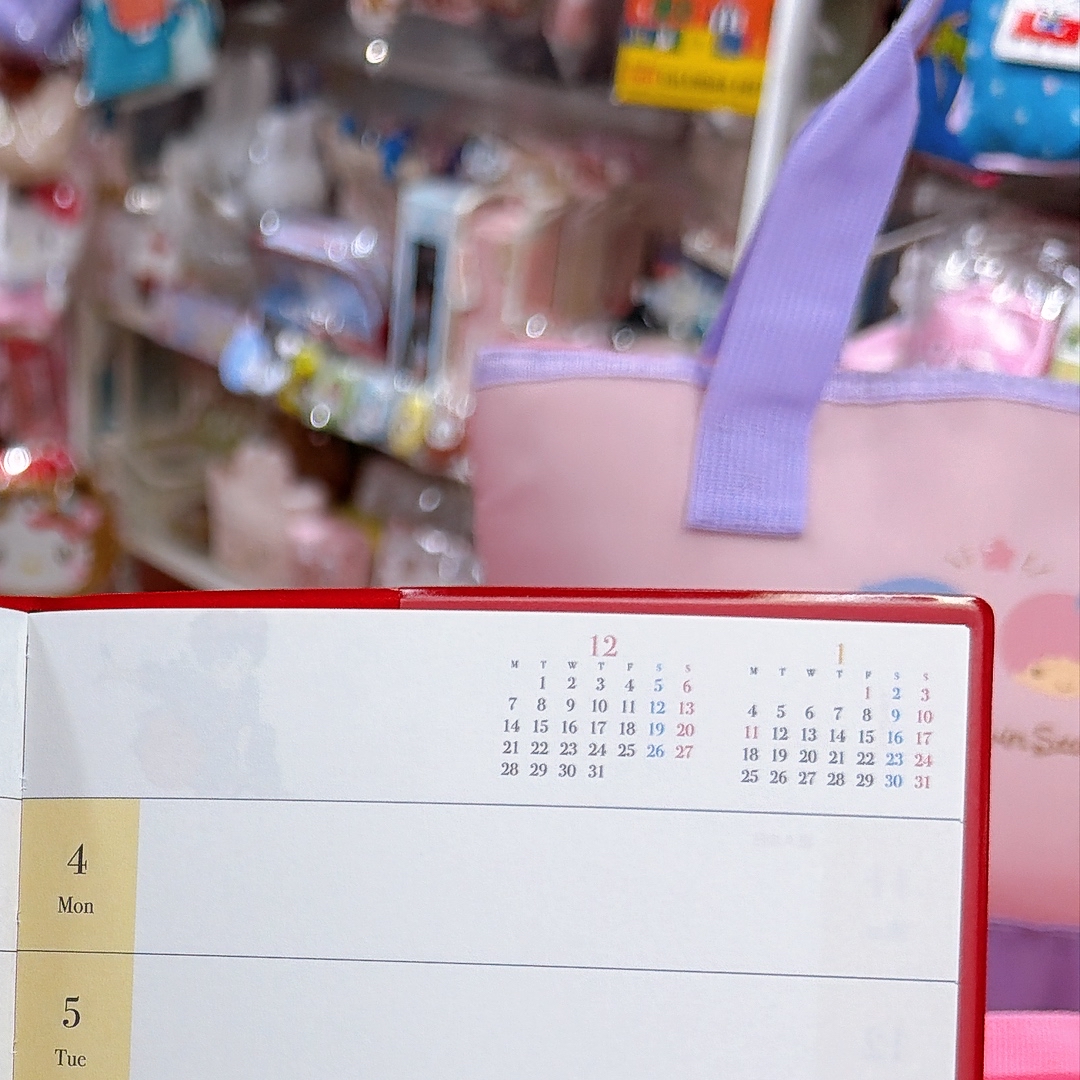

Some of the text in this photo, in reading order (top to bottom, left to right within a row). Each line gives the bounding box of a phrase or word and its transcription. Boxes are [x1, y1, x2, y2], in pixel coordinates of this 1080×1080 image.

[590, 635, 617, 657] 12
[836, 643, 845, 664] 1
[511, 660, 691, 673] M T W T F S S
[750, 667, 758, 675] M
[779, 667, 786, 676] T
[836, 670, 843, 678] T
[866, 671, 871, 679] F
[894, 672, 900, 680] S
[923, 673, 929, 681] S
[540, 676, 692, 693] 1 2 3 4 5 6
[865, 686, 930, 701] 1 2 3
[509, 697, 694, 715] 7 8 9 10 11 12 13
[748, 705, 934, 723] 4 5 6 7 8 9 10
[504, 719, 694, 736] 14 15 16 17 18 19 20
[746, 726, 933, 745] 11 12 13 14 15 16 17
[503, 741, 693, 758] 21 22 23 24 25 26 27
[743, 748, 932, 767] 18 19 20 21 22 23 24
[501, 762, 603, 778] 28 29 30 31
[741, 769, 929, 789] 25 26 27 28 29 30 31
[67, 844, 87, 874] 4
[58, 896, 93, 913] Mon
[63, 996, 80, 1028] 5
[55, 1049, 86, 1066] Tue
